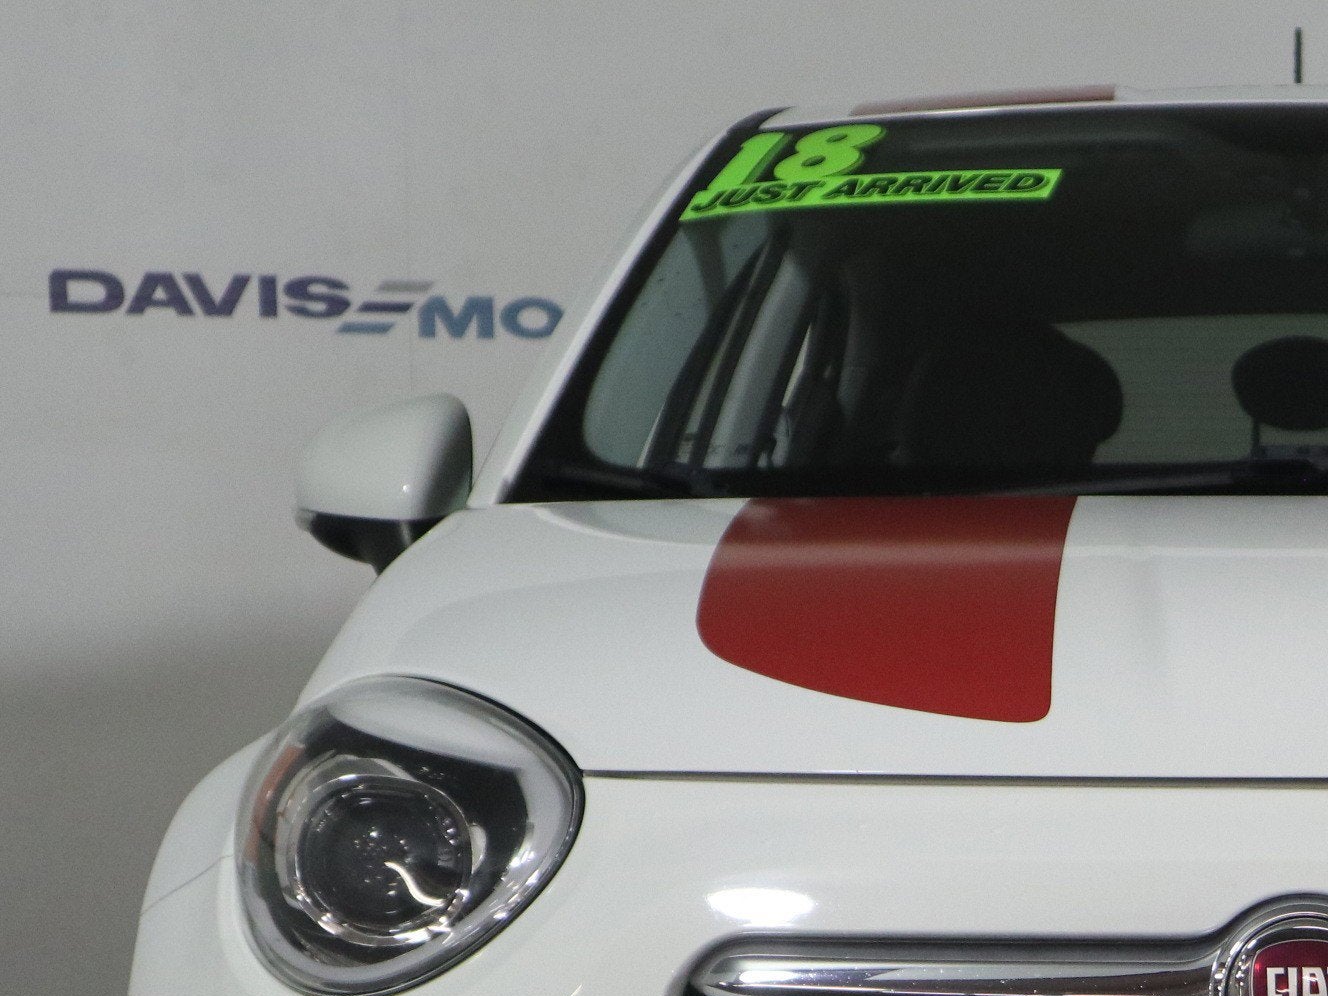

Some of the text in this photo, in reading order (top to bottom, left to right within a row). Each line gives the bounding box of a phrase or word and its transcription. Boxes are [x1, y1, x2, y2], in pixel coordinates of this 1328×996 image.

[704, 123, 888, 184] 18
[691, 172, 1049, 212] JUST ARRIVED
[49, 268, 350, 318] DAVIS
